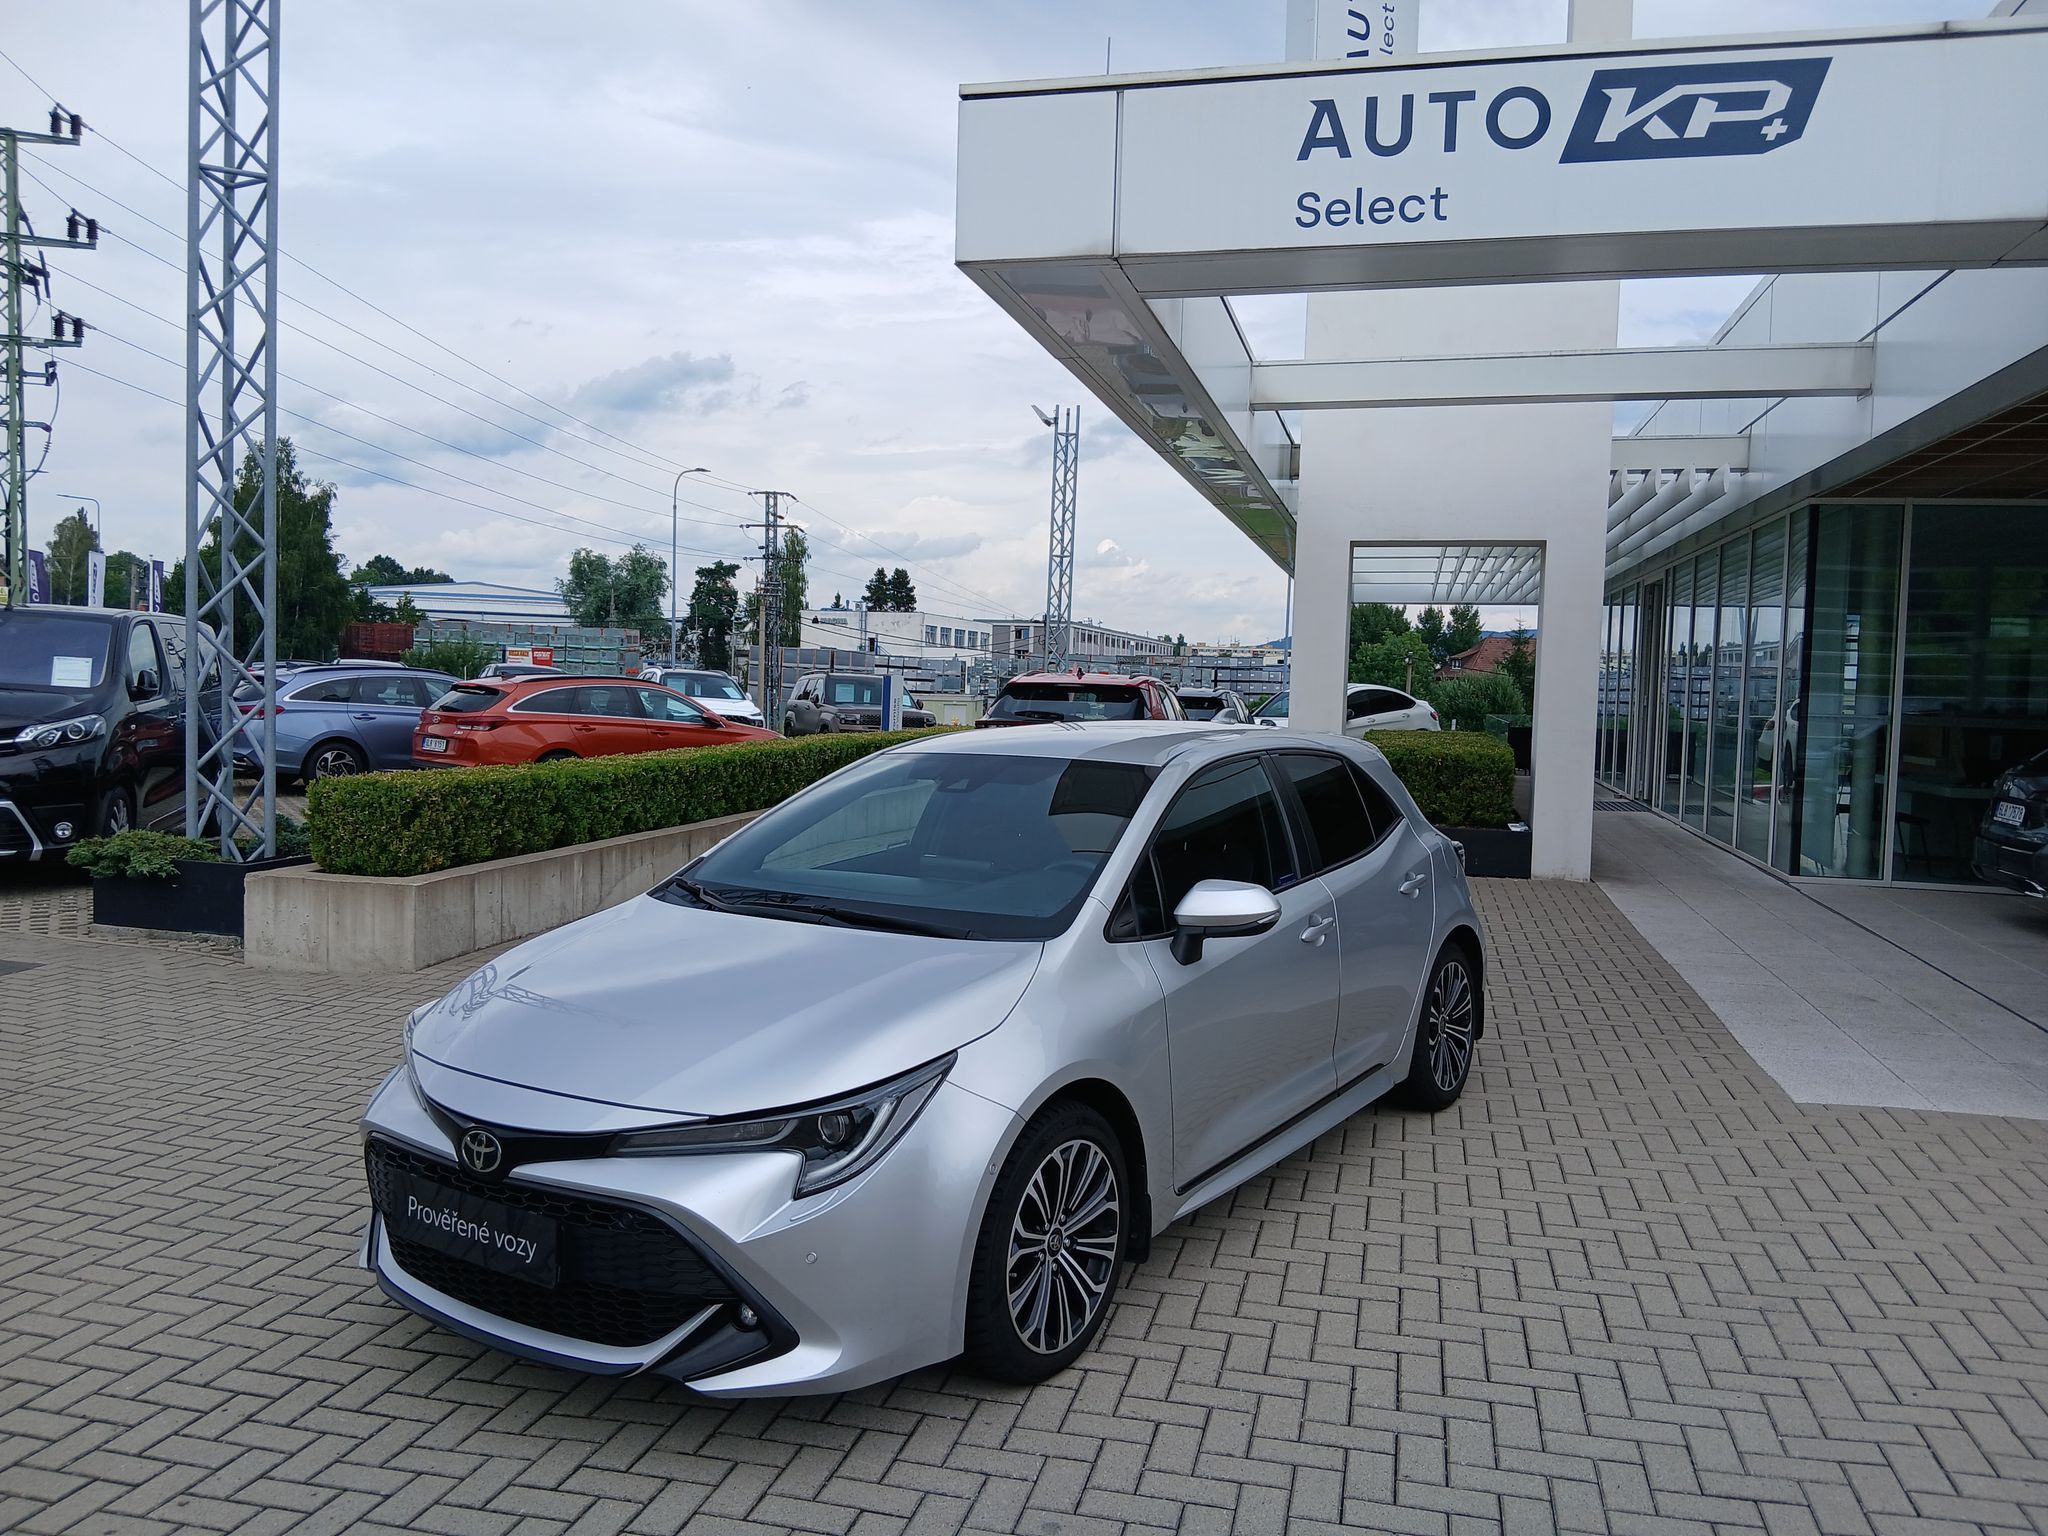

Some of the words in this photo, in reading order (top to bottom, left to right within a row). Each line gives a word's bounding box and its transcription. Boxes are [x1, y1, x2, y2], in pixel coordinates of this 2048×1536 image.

[1296, 86, 1552, 162] AUTO
[1295, 186, 1449, 228] Select
[408, 1195, 490, 1244] Prověřené
[494, 1230, 537, 1263] vozy
